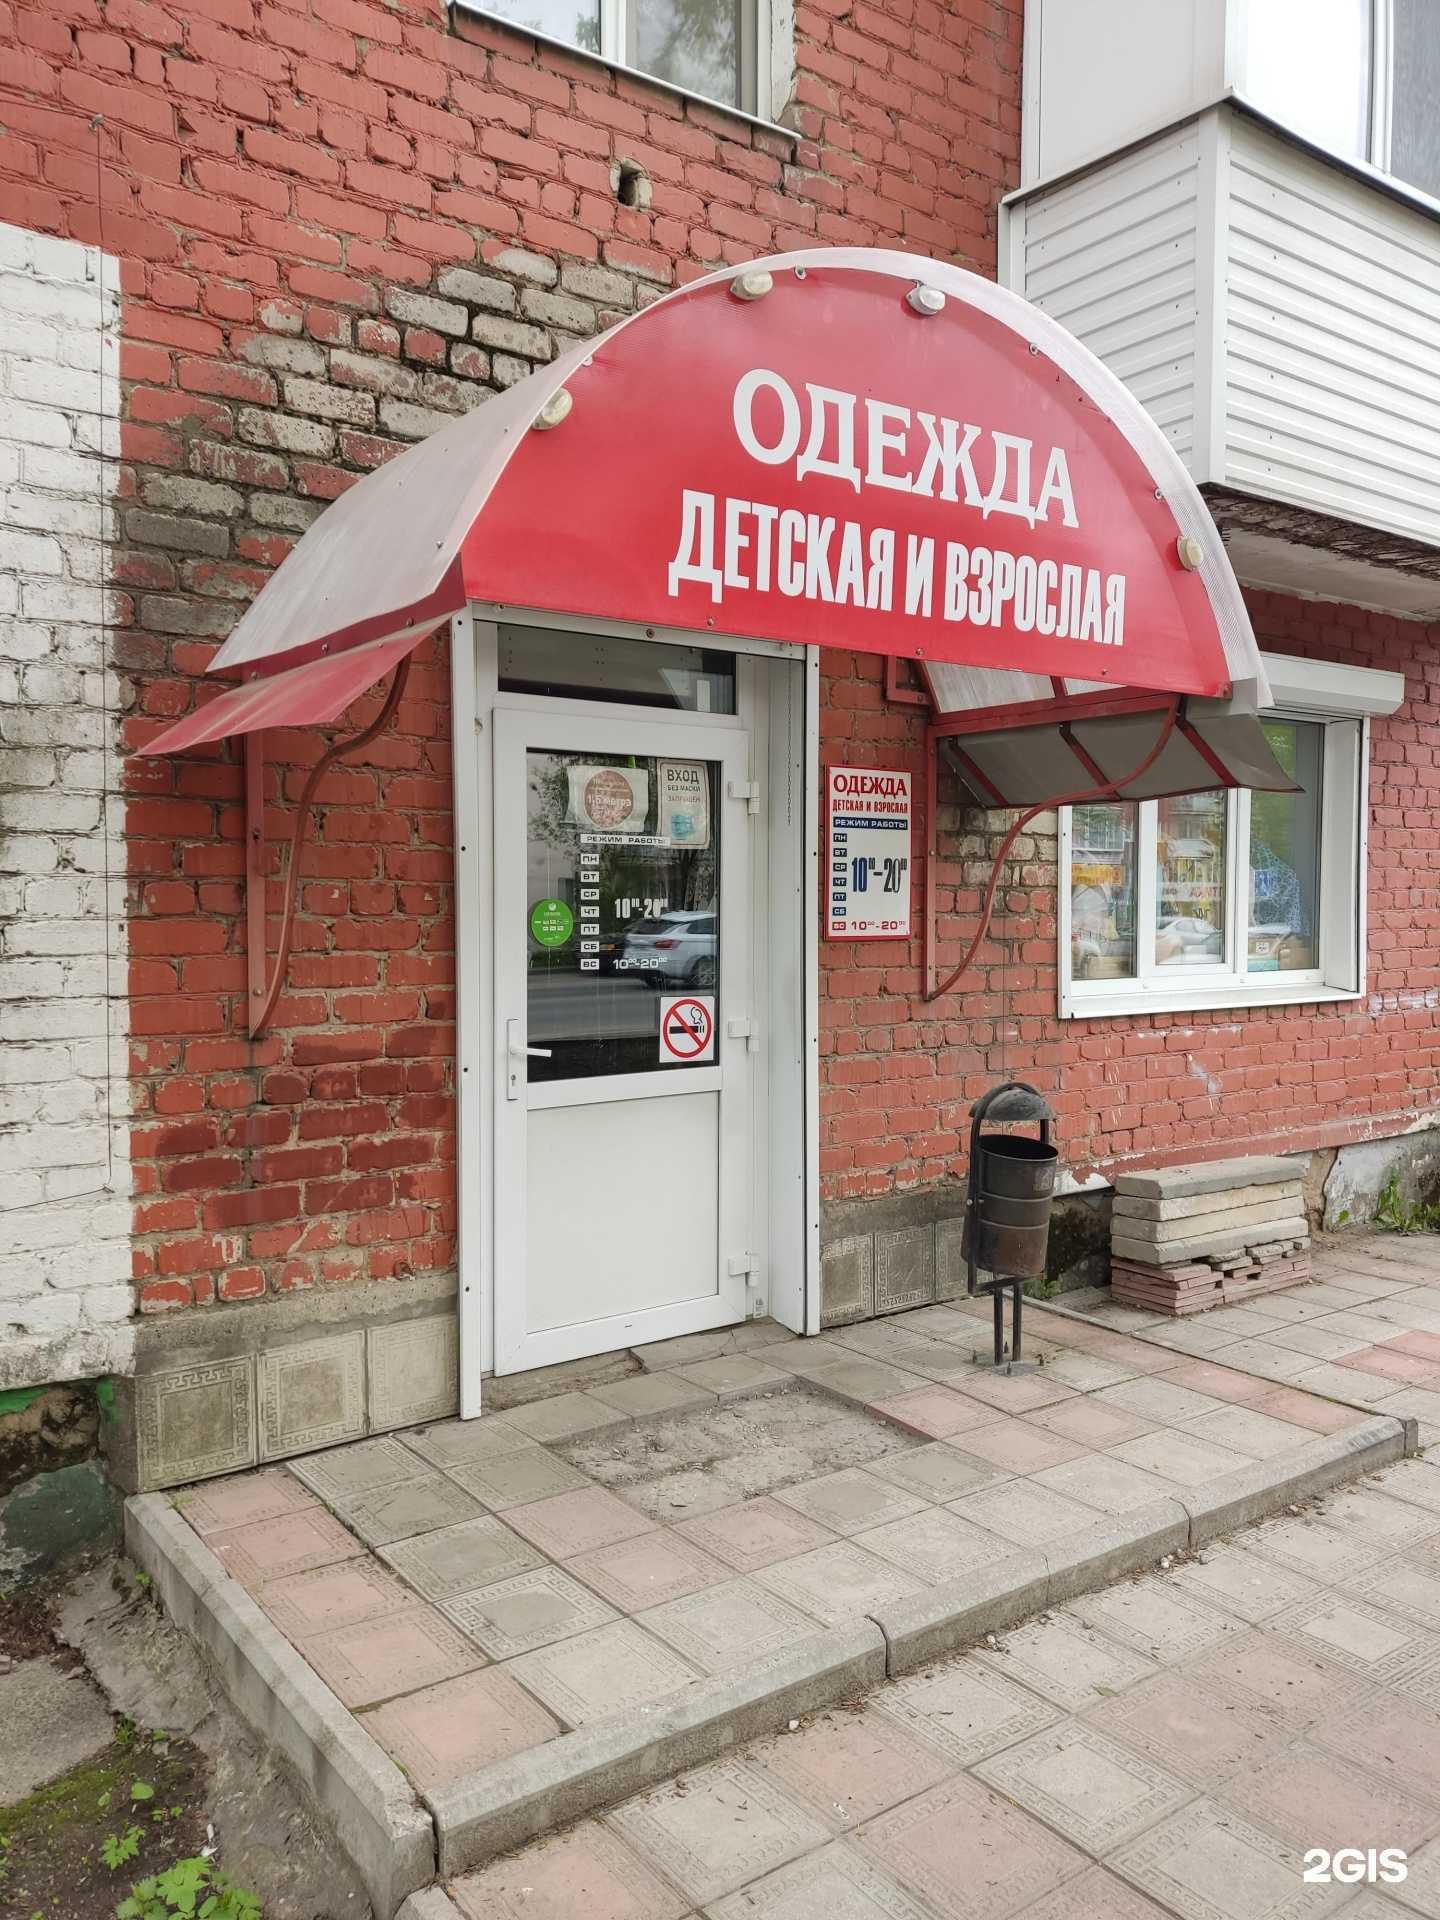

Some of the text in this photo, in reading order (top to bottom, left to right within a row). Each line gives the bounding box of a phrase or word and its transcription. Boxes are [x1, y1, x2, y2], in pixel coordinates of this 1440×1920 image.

[733, 368, 1080, 530] ОДЕЖДА
[667, 488, 1127, 646] ДЕТСКАЯ И ВЗРОСЛАЯ
[666, 768, 700, 785] ВХОД
[833, 774, 908, 800] ОДЕЖДА
[832, 799, 908, 814] ДЕТСКАЯ И ВЗРОСЛАЯ
[834, 818, 908, 829] РЕЖИМ РАБОТЫ
[586, 835, 623, 844] РЕЖИМ
[582, 855, 598, 863] ПН
[834, 863, 846, 871] СР
[833, 907, 846, 915] СБ
